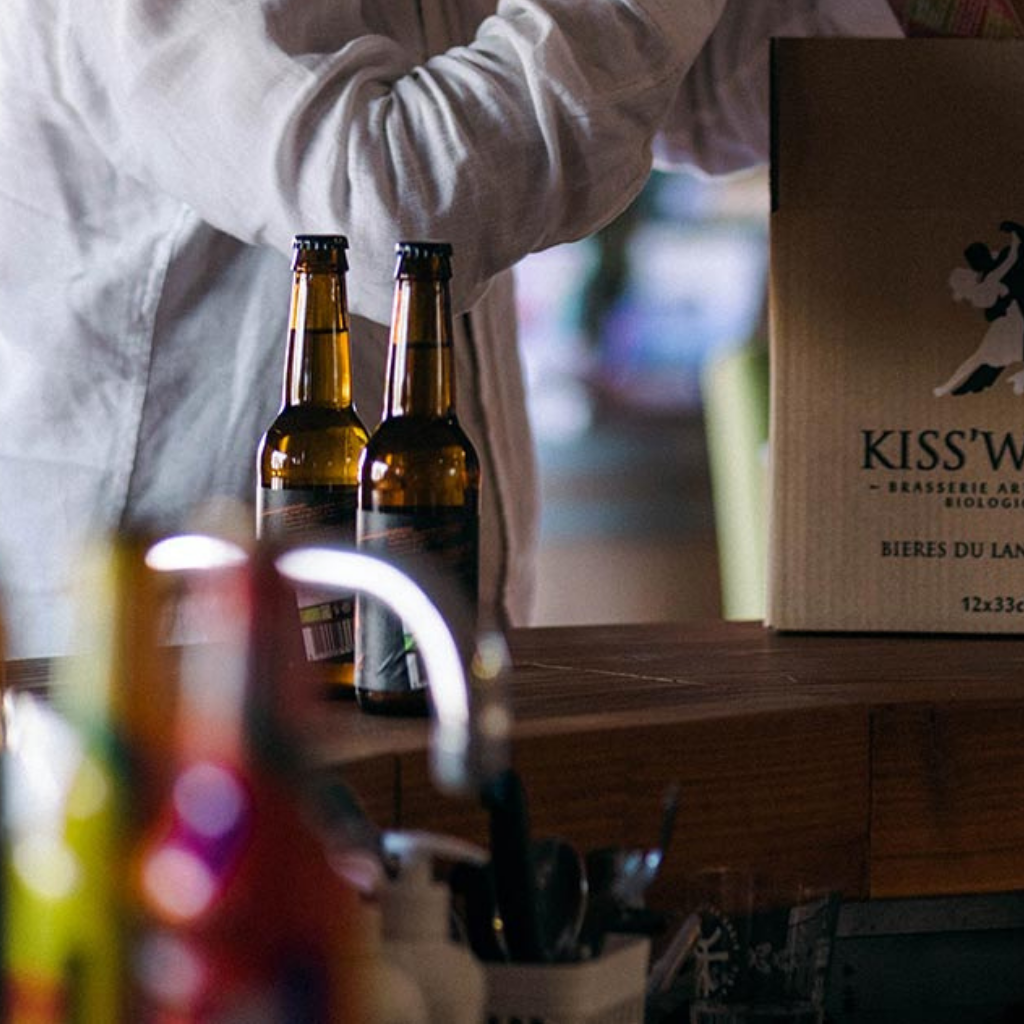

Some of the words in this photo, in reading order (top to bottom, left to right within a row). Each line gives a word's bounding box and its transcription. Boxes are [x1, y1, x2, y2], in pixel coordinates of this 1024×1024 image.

[888, 481, 988, 494] BRASSERIE
[881, 541, 947, 559] BIERES
[954, 542, 984, 559] DU
